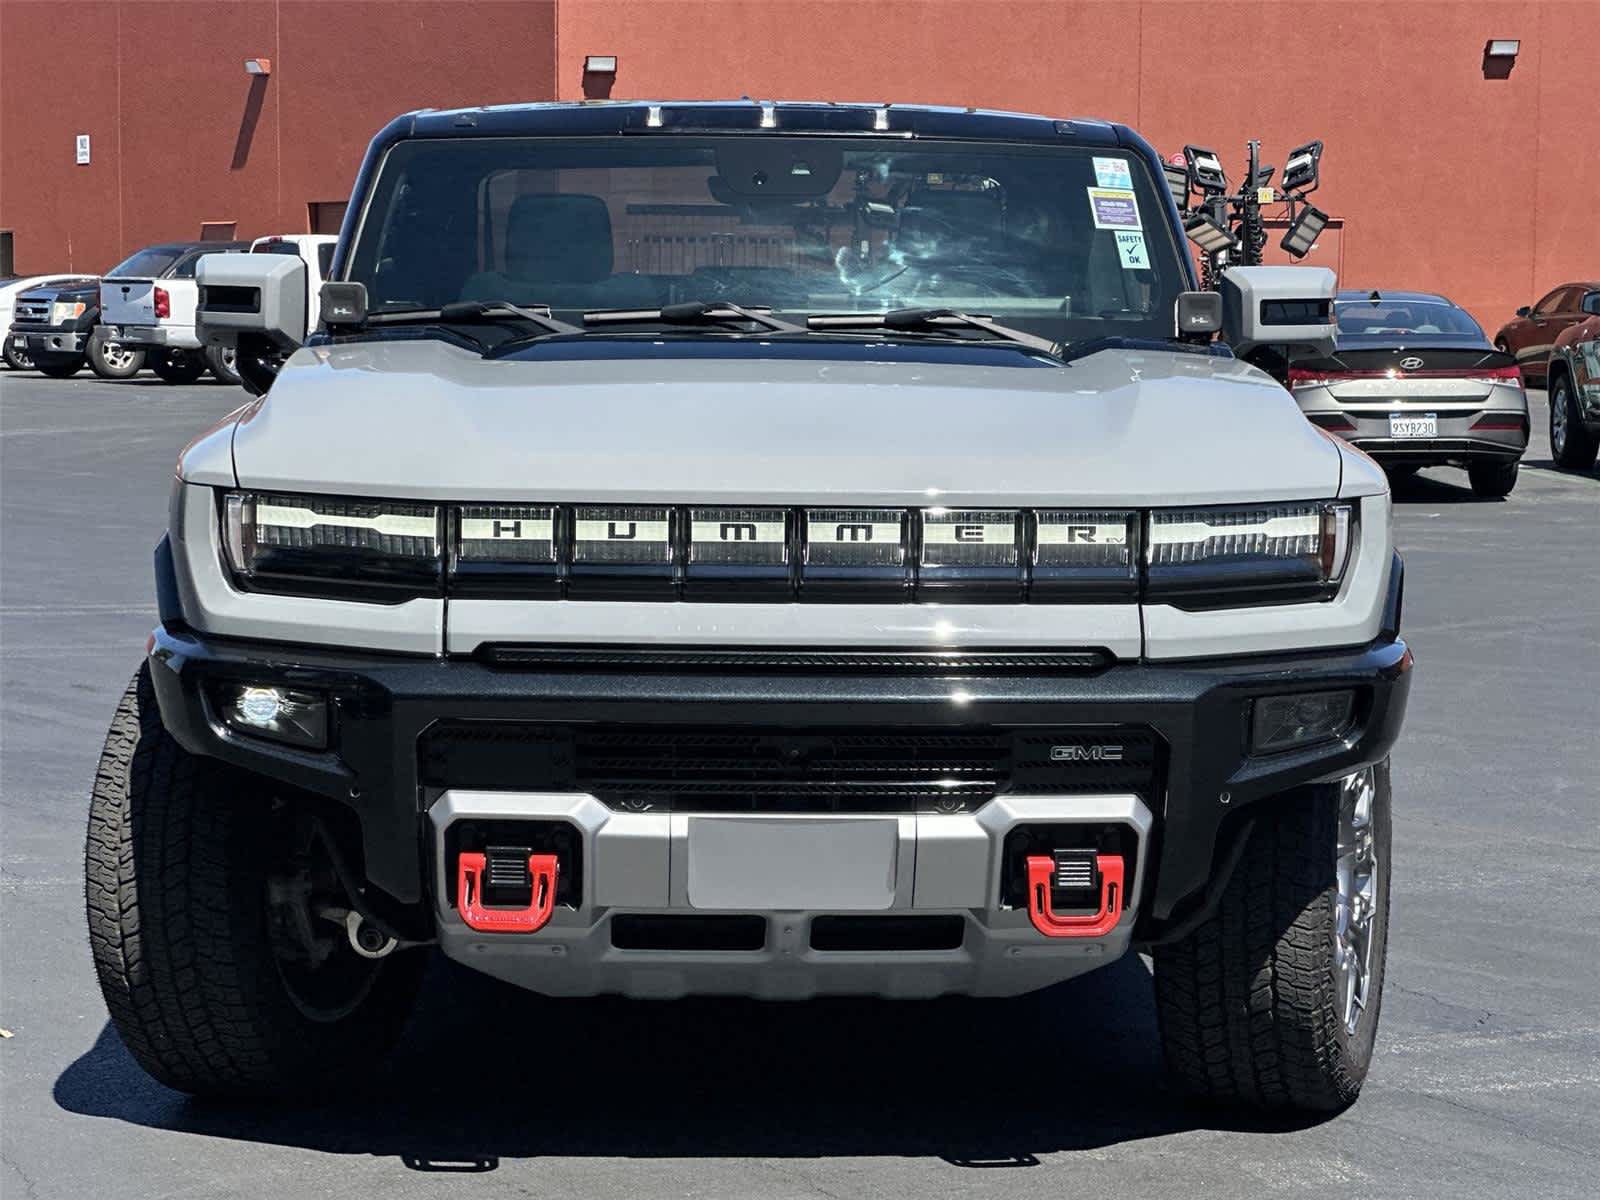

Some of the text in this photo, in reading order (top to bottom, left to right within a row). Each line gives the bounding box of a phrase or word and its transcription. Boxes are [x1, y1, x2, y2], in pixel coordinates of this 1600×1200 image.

[1117, 234, 1142, 244] SAFETY
[1128, 255, 1142, 264] OK
[493, 520, 1097, 543] HUMMER
[1051, 745, 1123, 760] GMC
